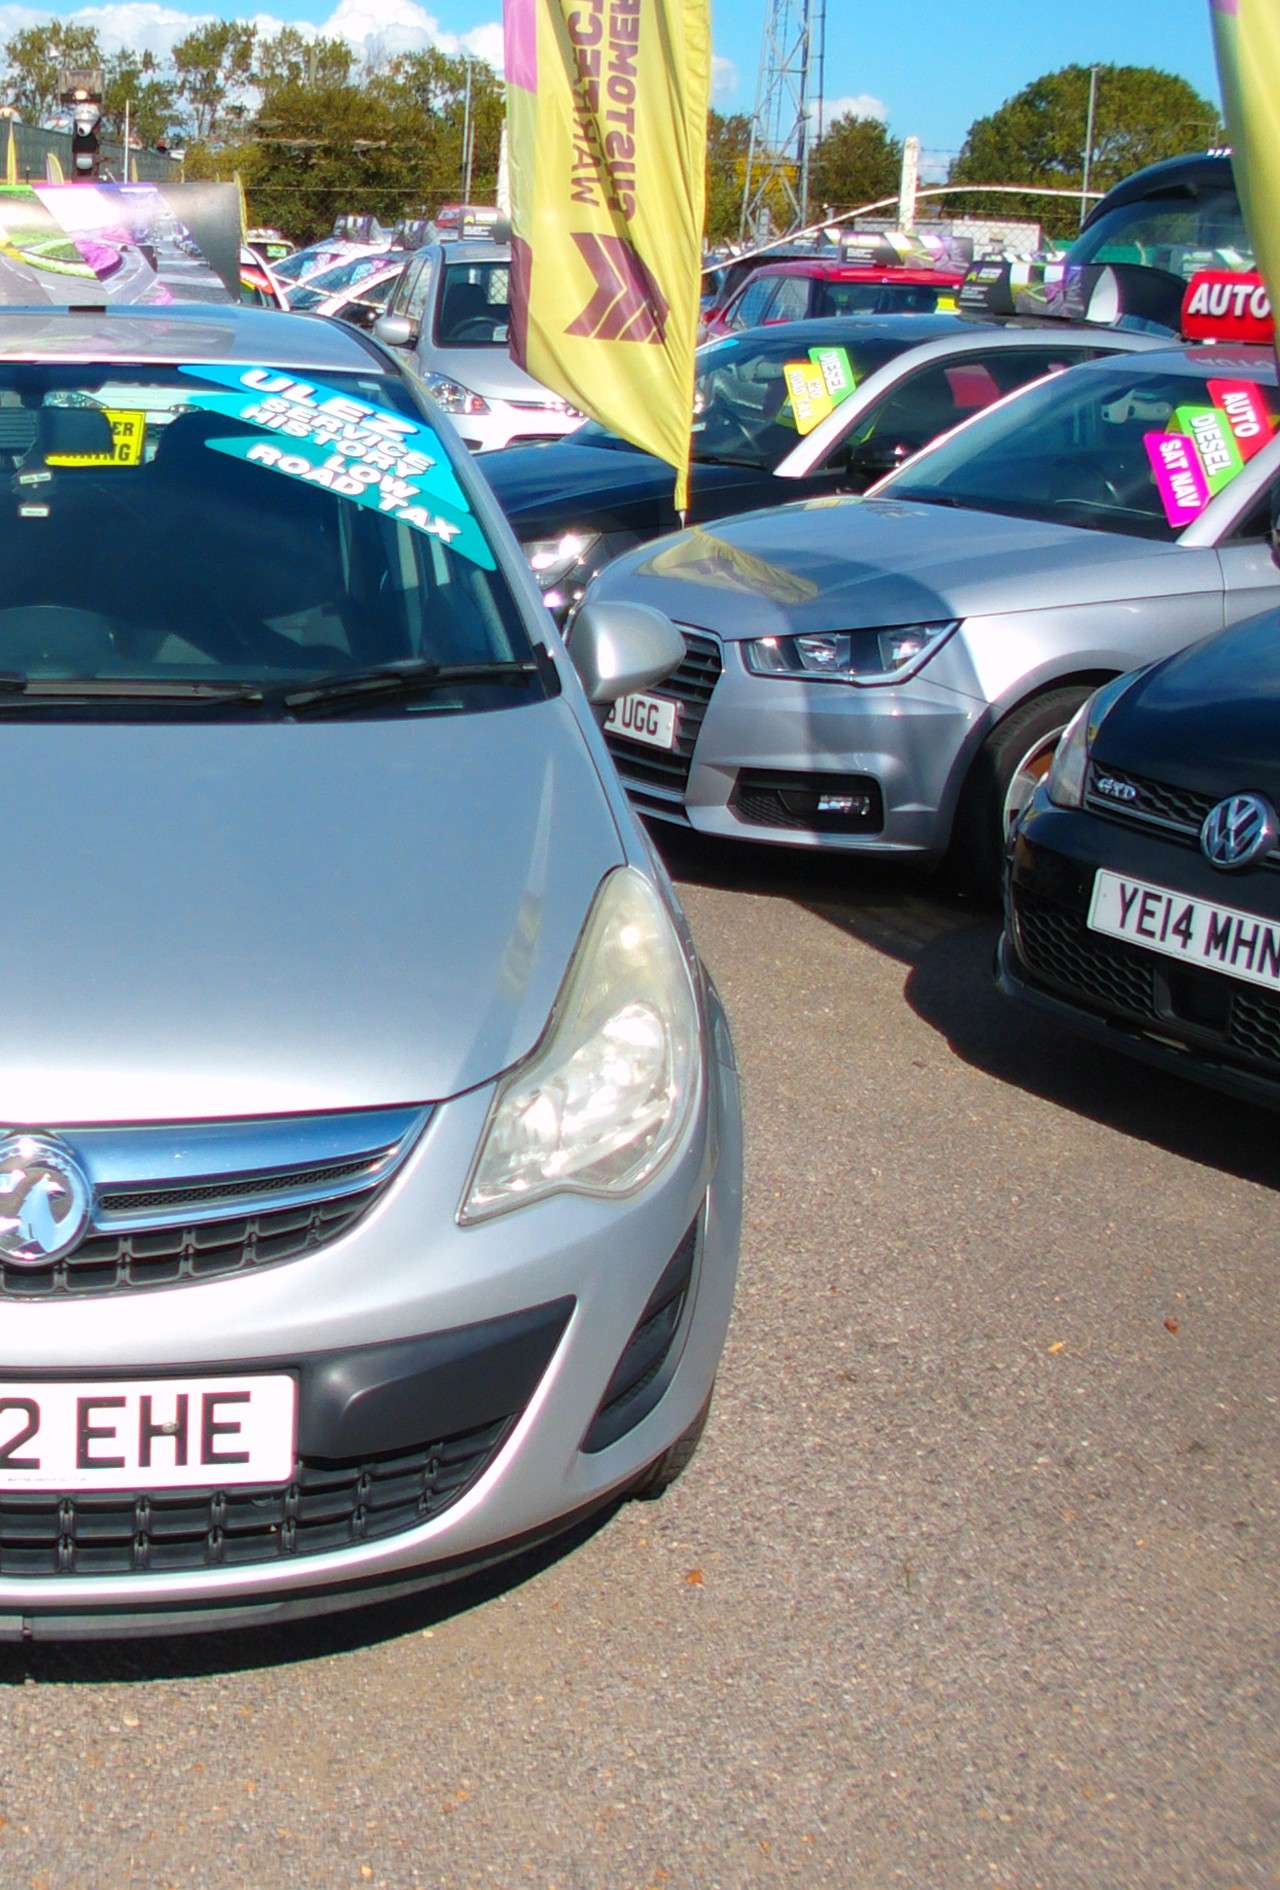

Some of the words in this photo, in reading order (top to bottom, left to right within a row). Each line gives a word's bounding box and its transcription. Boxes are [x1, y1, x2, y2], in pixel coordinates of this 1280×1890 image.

[240, 368, 419, 443] ULEZ
[260, 396, 438, 470] SERVICE
[1222, 391, 1261, 438] AUTO
[239, 404, 430, 478] HISTORY
[1159, 439, 1189, 470] SAT
[1190, 412, 1232, 477] DIESEL
[246, 442, 366, 496] ROAD
[378, 491, 463, 543] TAX
[323, 454, 421, 500] LOW
[1169, 473, 1201, 508] NAV
[622, 696, 659, 736] UGG
[1119, 883, 1194, 950] YE14
[1203, 911, 1280, 979] MHN
[75, 1391, 252, 1469] EHE
